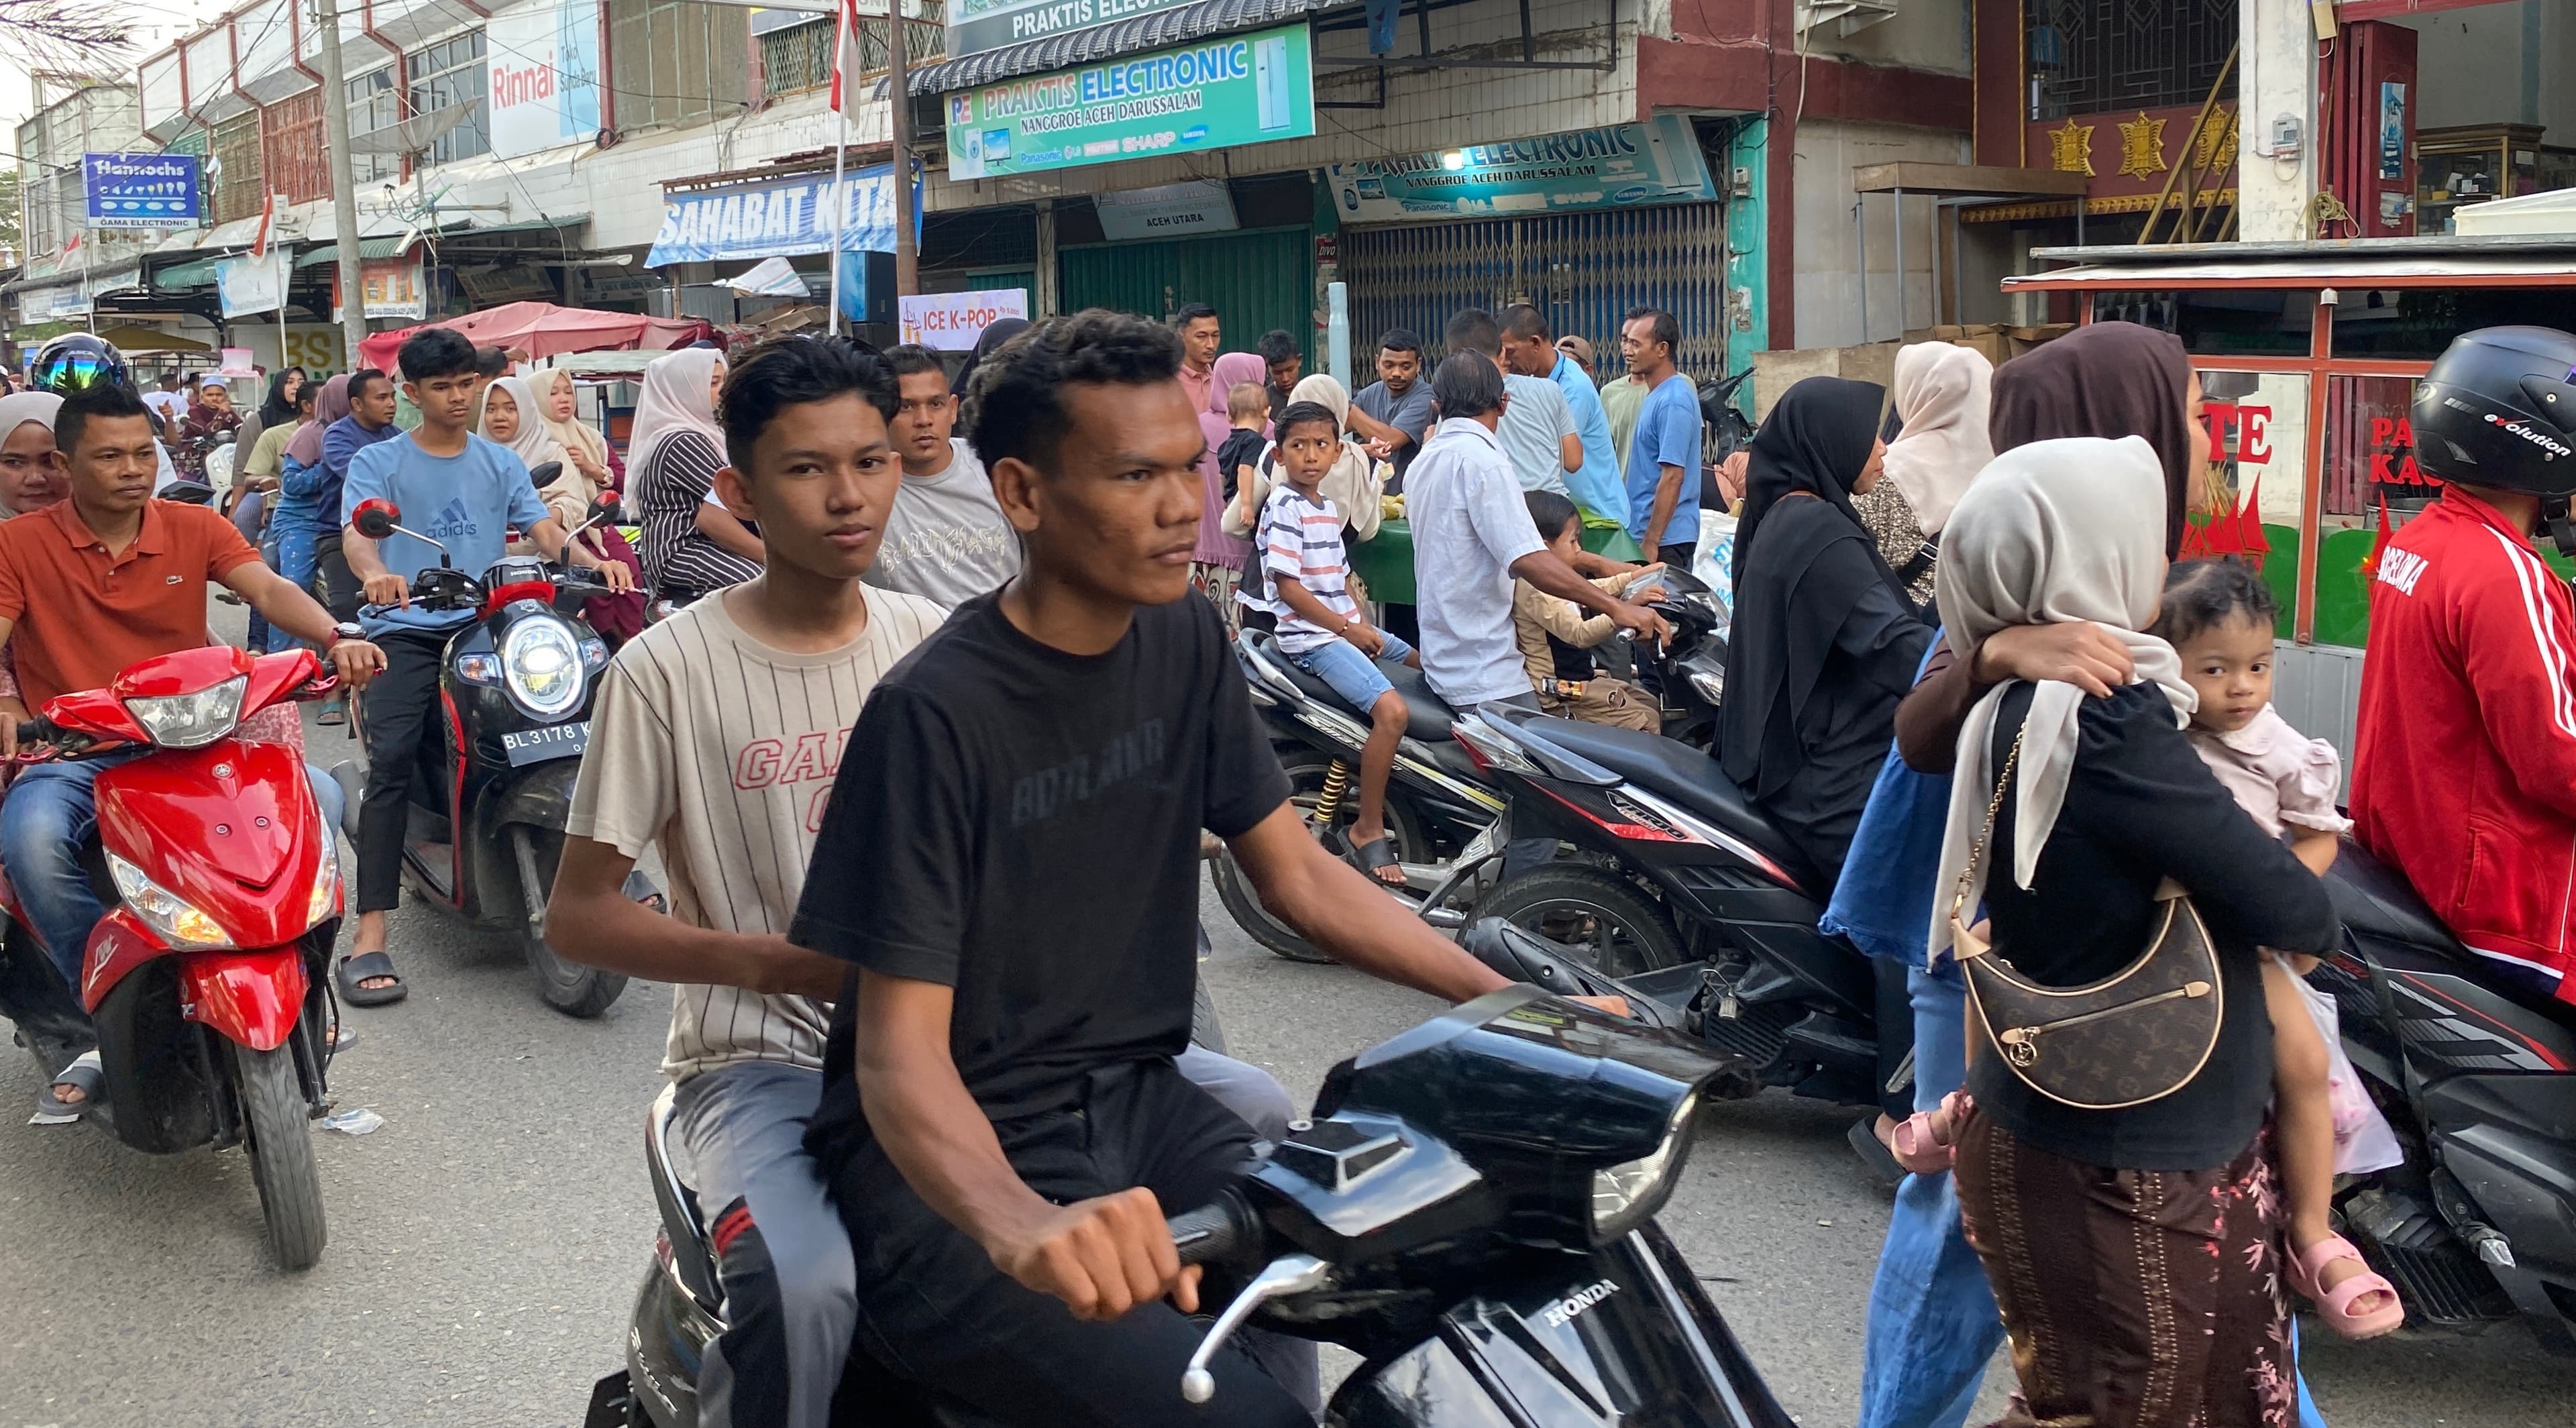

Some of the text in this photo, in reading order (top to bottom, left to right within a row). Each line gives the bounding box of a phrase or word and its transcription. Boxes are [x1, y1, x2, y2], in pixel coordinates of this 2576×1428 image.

[1013, 1, 1092, 38] PRAKTIS
[494, 50, 553, 110] Rinnai
[983, 41, 1247, 119] PRAKTIS ELECTRONIC
[951, 95, 971, 125] PE
[1021, 91, 1201, 133] NANGGROE ACEH DARUSSALAM
[1020, 148, 1062, 164] Panasonic
[1123, 132, 1175, 152] SHARP
[93, 160, 185, 176] Hannochs
[1405, 176, 1468, 188] NANGGROE
[1470, 171, 1502, 183] ACEH
[1505, 165, 1596, 181] DARUSSALAM
[655, 174, 897, 246] SAHABAT KITA
[1146, 217, 1171, 227] ACEH
[1173, 213, 1204, 225] UTARA
[1405, 201, 1449, 213] Panasonic
[1319, 245, 1336, 256] DIVO
[924, 309, 996, 330] ICE K-POP
[2203, 403, 2273, 465] TE
[2371, 418, 2415, 447] PA
[2484, 414, 2571, 456] evolution
[2369, 453, 2445, 486] KA
[503, 733, 529, 749] BL
[529, 725, 576, 744] 3178
[1607, 791, 1686, 838] VARIO
[1544, 1278, 1621, 1327] HONDA
